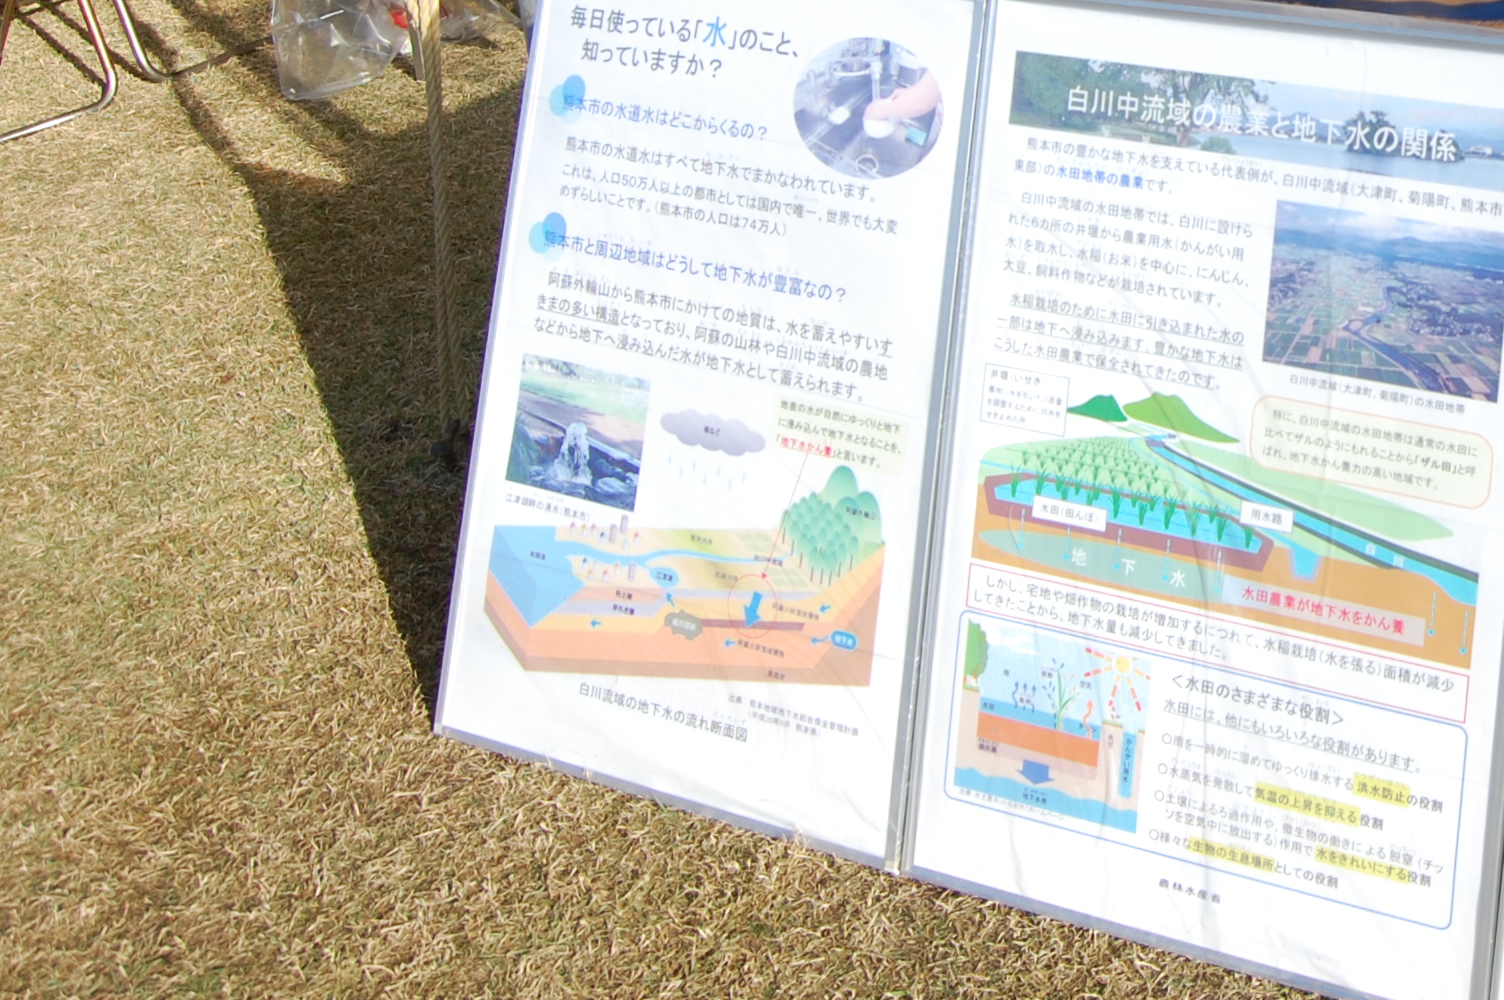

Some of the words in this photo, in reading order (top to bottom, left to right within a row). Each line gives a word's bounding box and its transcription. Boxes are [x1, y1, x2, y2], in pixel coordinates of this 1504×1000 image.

[570, 4, 800, 58] 毎日使っている「水」のこと、
[580, 39, 723, 79] 知っていますか？
[562, 92, 768, 140] 熊本市の水道水はどこからくるの？
[1067, 85, 1459, 163] 白川中流域の農業と地下水の関係
[565, 136, 876, 203] 熊本市の水道水はすべて地下水でまかなわれています。
[1013, 158, 1174, 195] 東部）の水田地帯の農業です。
[561, 163, 899, 235] これは、人口50万人以上の都市としては国内で唯一、世界でも大変
[1021, 190, 1254, 239] 白川中流域の水田地帯では、白川に設けら
[542, 230, 847, 302] 熊本市と周辺地域はどうして地下水が豊富なの？
[1003, 259, 1222, 308] 大豆、飼料作物などが栽培されています。
[537, 294, 888, 381] きまの多い構造となっており、阿蘇の山林や白川中流域の農地
[548, 271, 893, 353] 阿蘇外輪山から熊本市にかけての地質は、水を蓄えやすいす
[1010, 292, 1245, 345] 水稲栽培のために水田に引き込まれた水の
[534, 316, 863, 402] などから地下へ浸み込んだ水が地下水として蓄えられます。
[994, 336, 1220, 390] こうした水田農業で保全されてきたのです。
[973, 590, 1229, 661] してきたことから、地下水量も減少してきました。
[1242, 585, 1406, 637] 水田農業が地下水をかん養
[579, 682, 748, 742] 白川流域の地下水の流れ断面図
[1163, 700, 1420, 773] 水田には、他にもいろいろな役割があります。
[1159, 878, 1221, 904] 農林水産省
